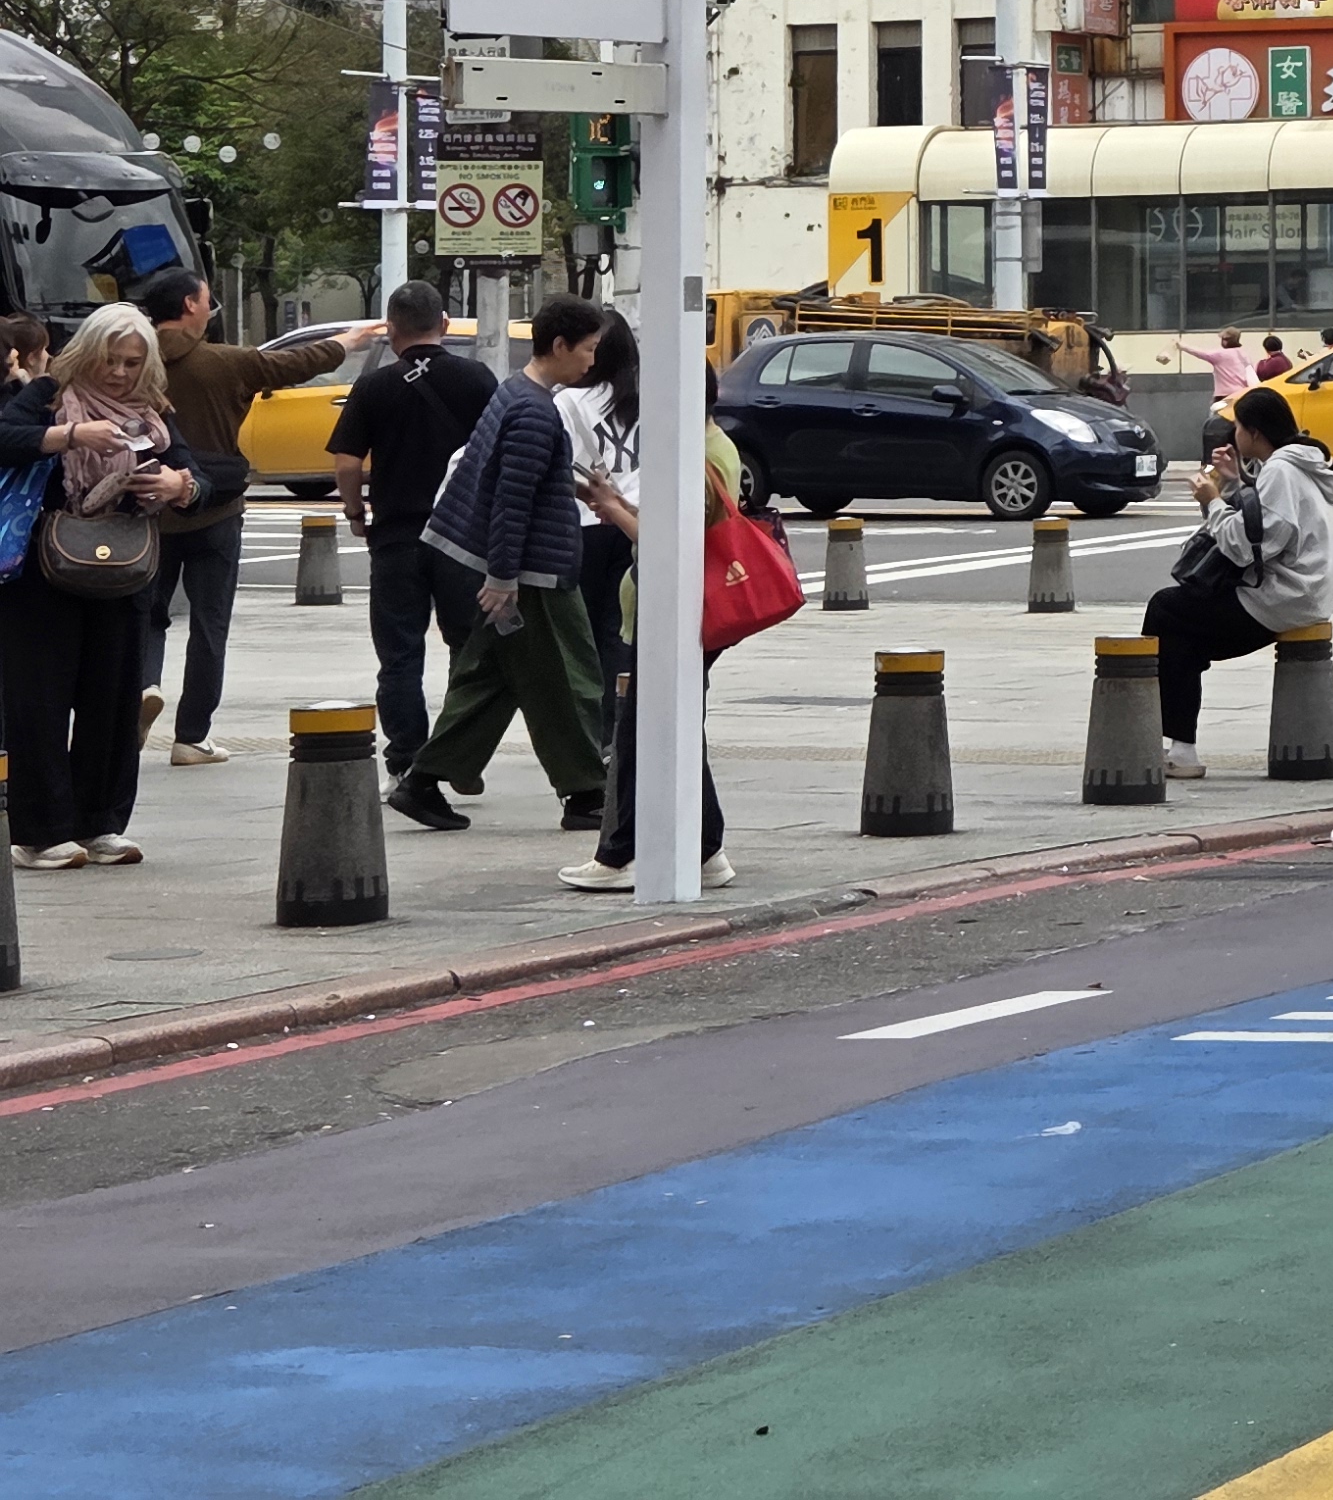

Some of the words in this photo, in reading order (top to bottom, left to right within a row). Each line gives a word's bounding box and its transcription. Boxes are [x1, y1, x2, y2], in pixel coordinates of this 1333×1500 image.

[1275, 54, 1303, 116] 女醫
[856, 218, 883, 283] 1
[1261, 223, 1302, 240] Slo
